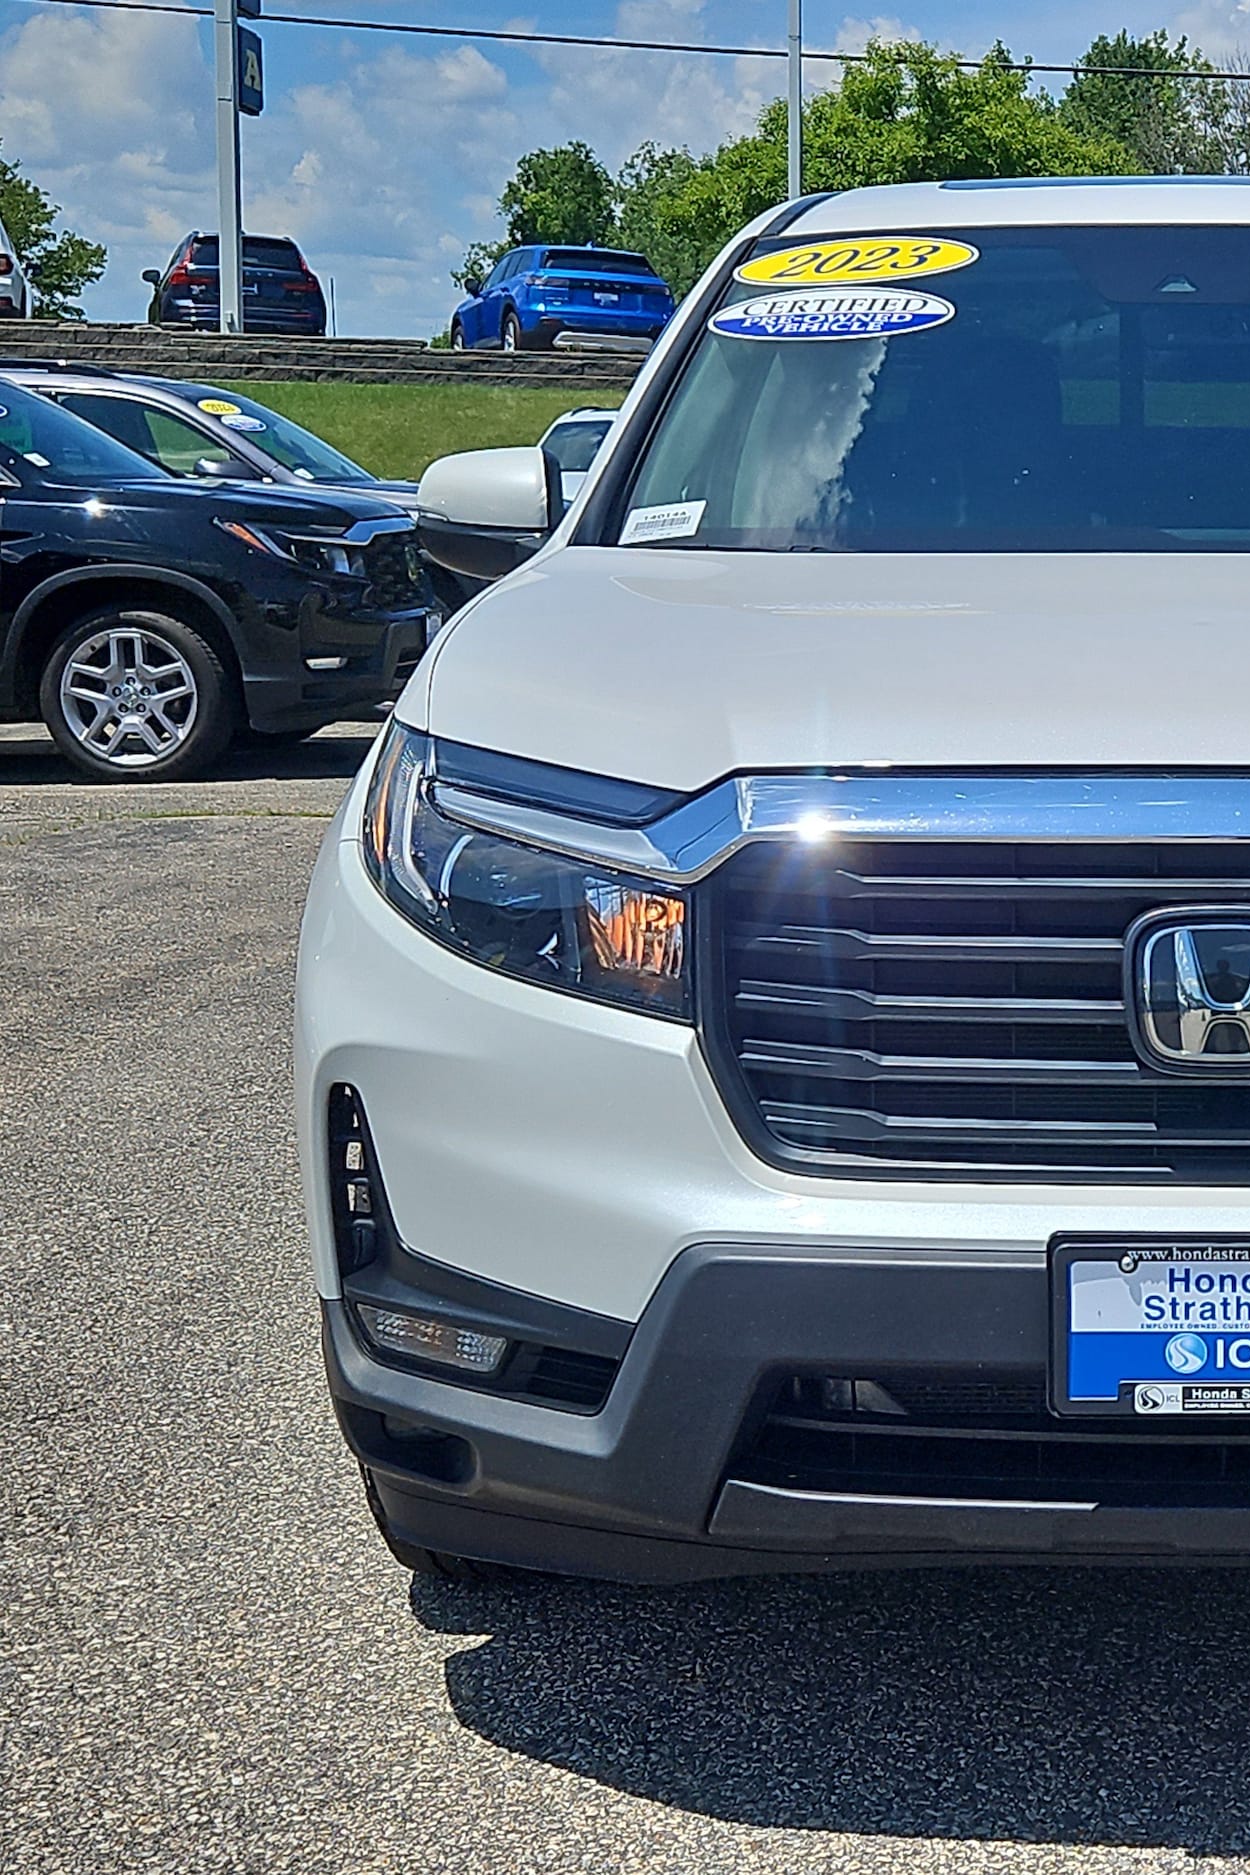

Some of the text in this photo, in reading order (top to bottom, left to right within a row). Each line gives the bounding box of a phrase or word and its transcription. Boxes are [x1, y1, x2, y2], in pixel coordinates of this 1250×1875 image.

[244, 49, 262, 92] A
[769, 245, 942, 279] 2023
[743, 297, 929, 317] CERTIFIED
[741, 313, 914, 328] PRE-OWNED
[765, 321, 886, 334] VEHICLE
[1192, 1388, 1238, 1399] Honda
